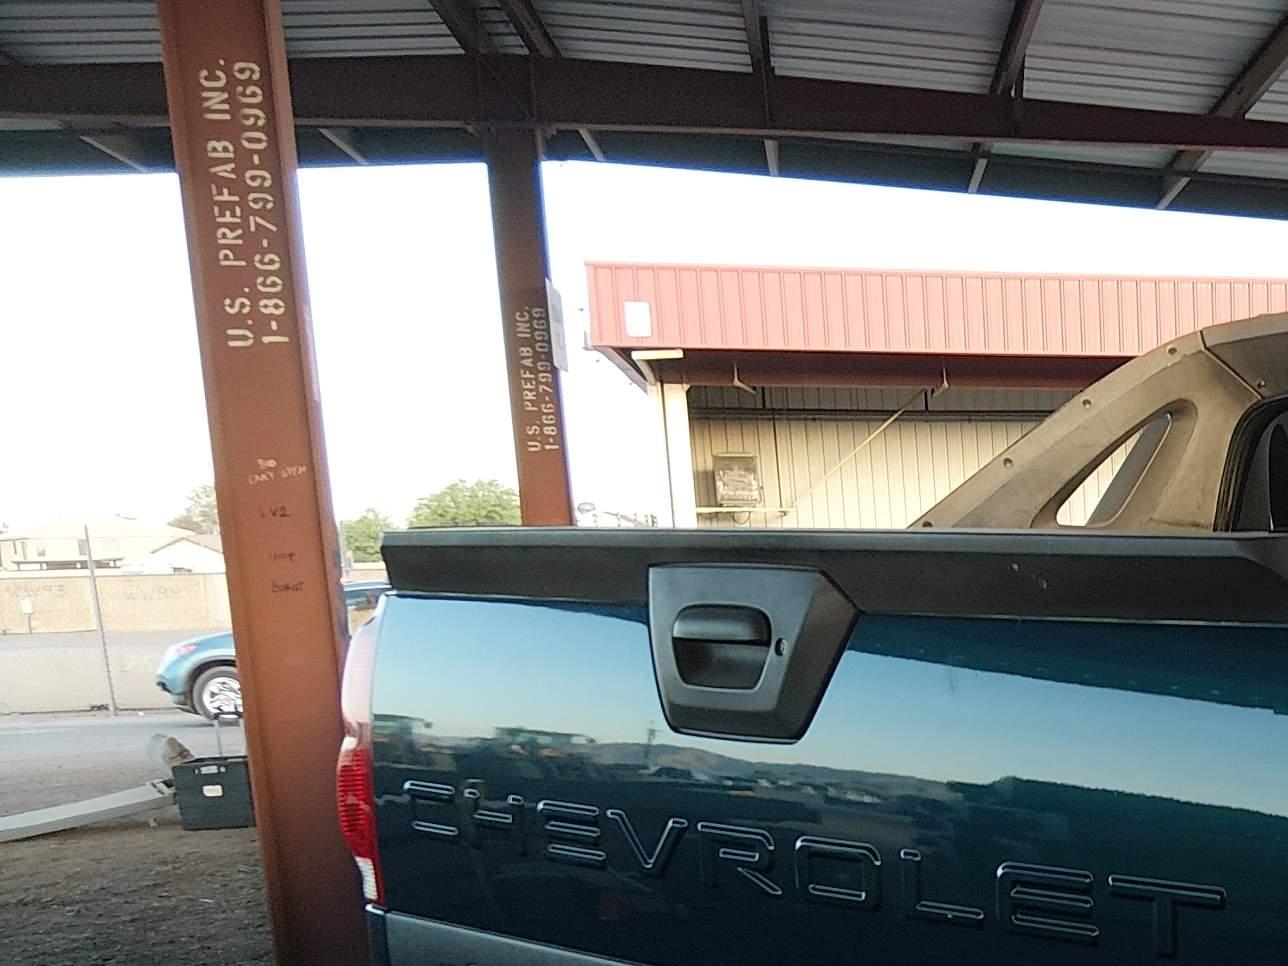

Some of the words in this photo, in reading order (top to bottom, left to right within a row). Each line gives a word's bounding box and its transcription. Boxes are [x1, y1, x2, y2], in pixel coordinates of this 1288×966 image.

[199, 58, 231, 120] INC.
[206, 140, 247, 266] PREFAB
[232, 61, 290, 344] 1-866-799-0969
[224, 287, 254, 347] U.S.
[516, 306, 531, 337] INC.
[519, 347, 538, 410] PREFAB
[532, 308, 558, 450] 1-866-799-0969
[526, 421, 541, 451] U.S.
[403, 779, 1228, 956] CHEVROLET
